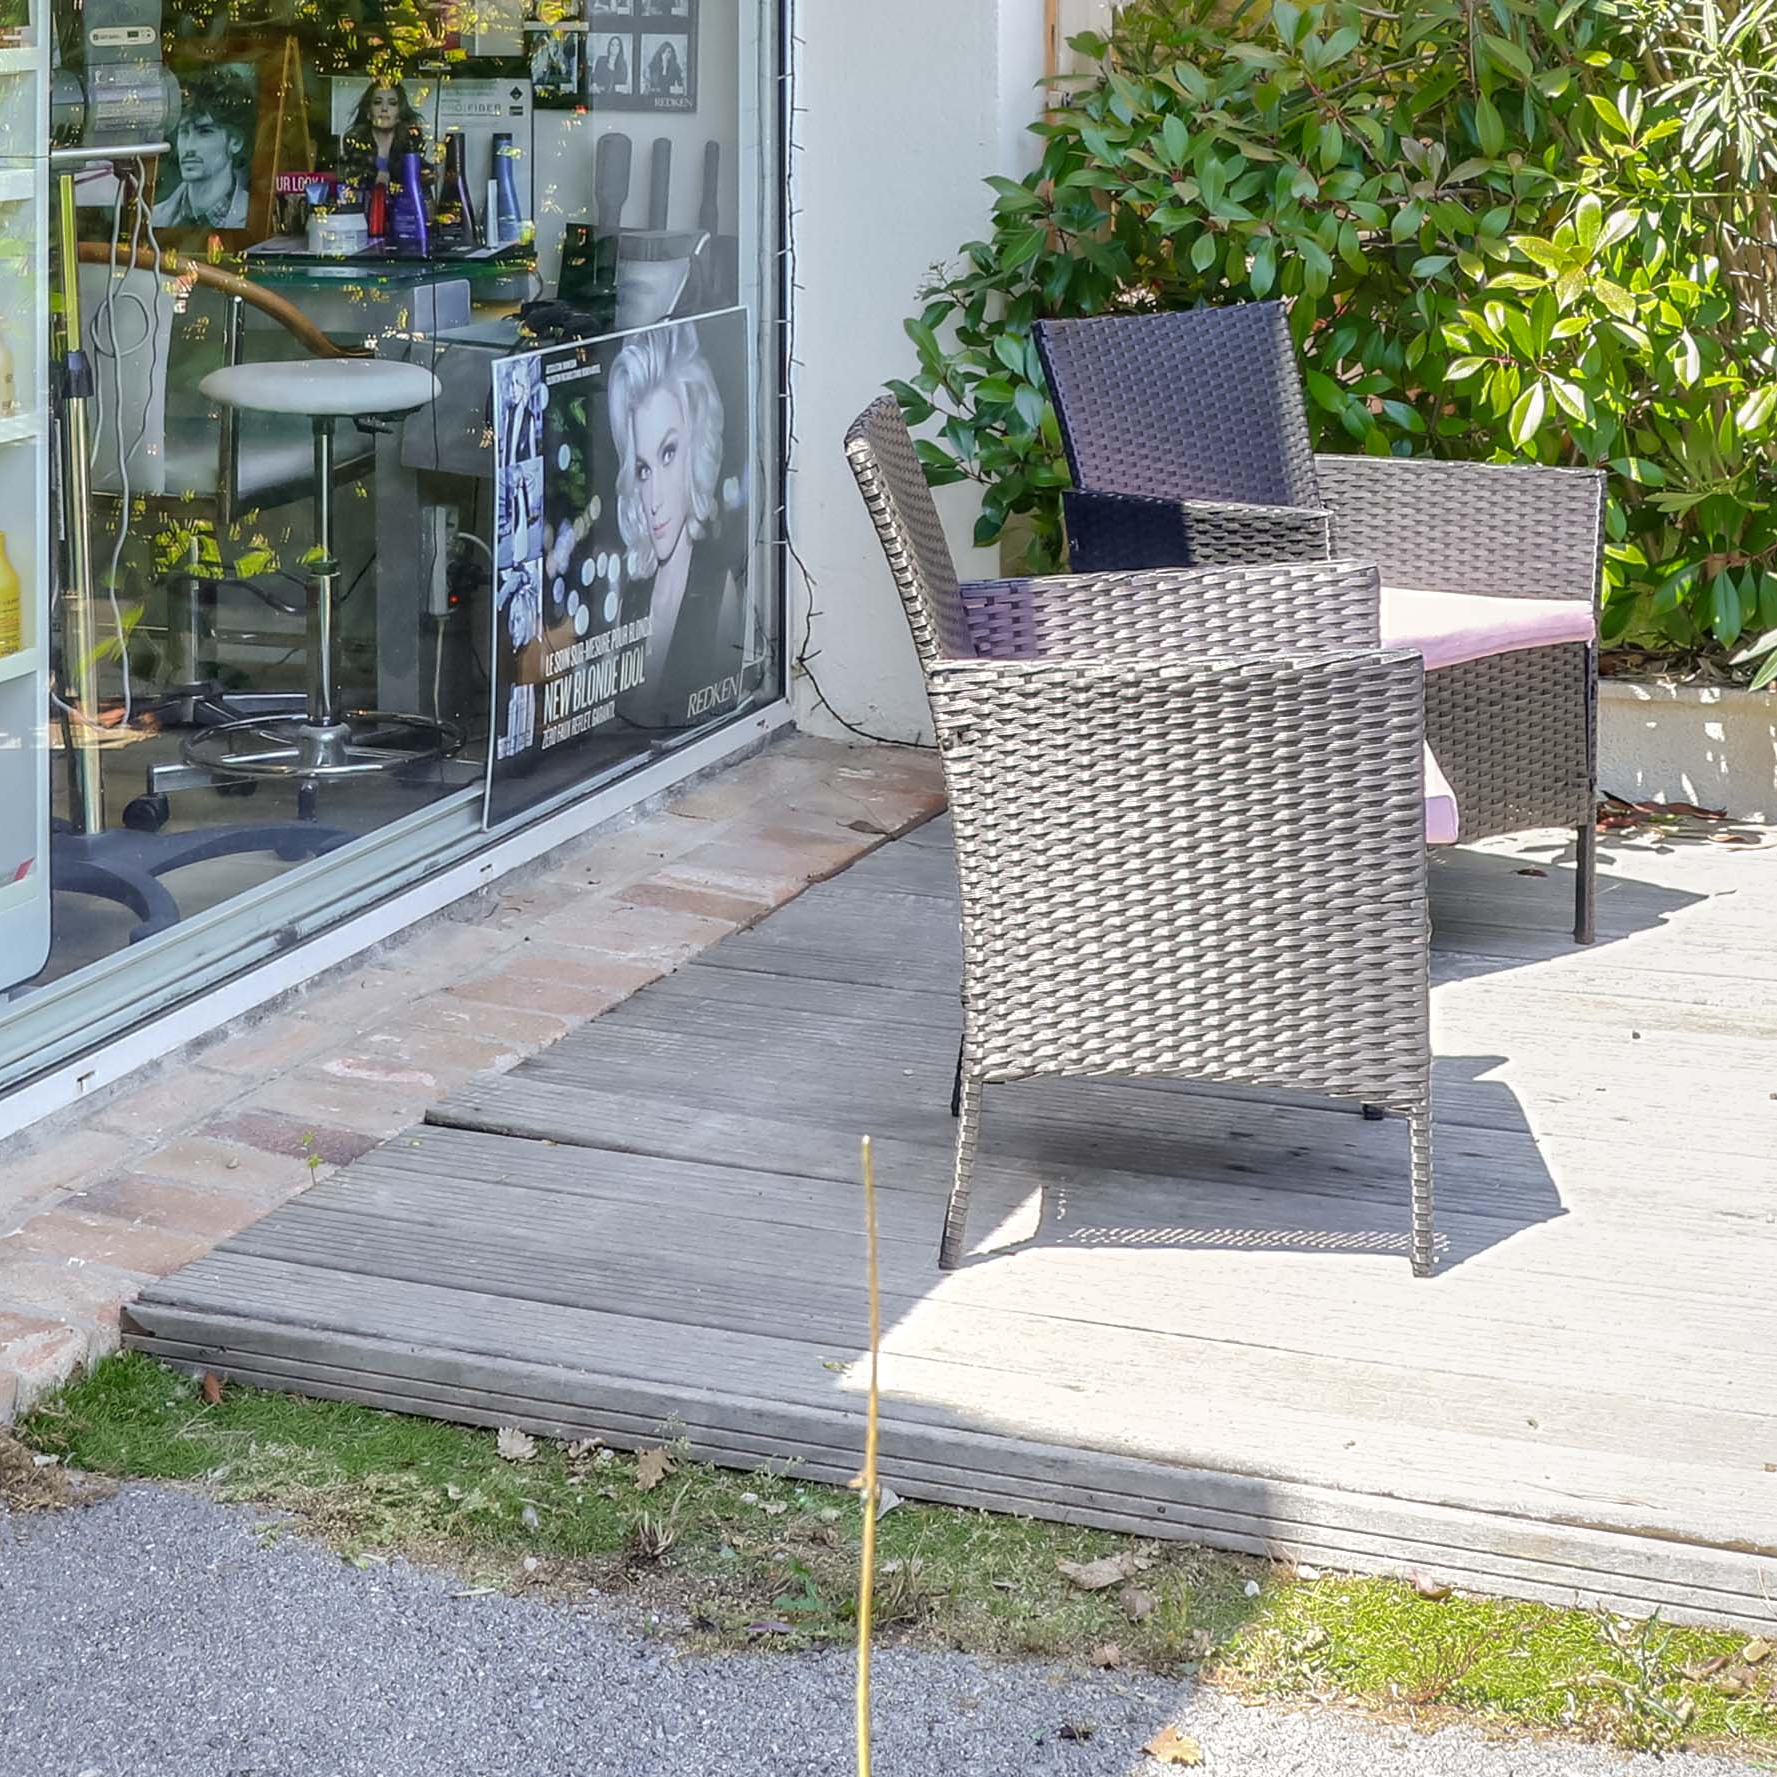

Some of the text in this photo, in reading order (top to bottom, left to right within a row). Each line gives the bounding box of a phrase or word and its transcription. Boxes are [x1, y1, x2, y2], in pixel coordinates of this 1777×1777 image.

[654, 97, 693, 108] REDKEN
[545, 654, 553, 677] LE
[544, 645, 645, 724] NEW BLONDE IDOL
[687, 674, 739, 718] REDKEN
